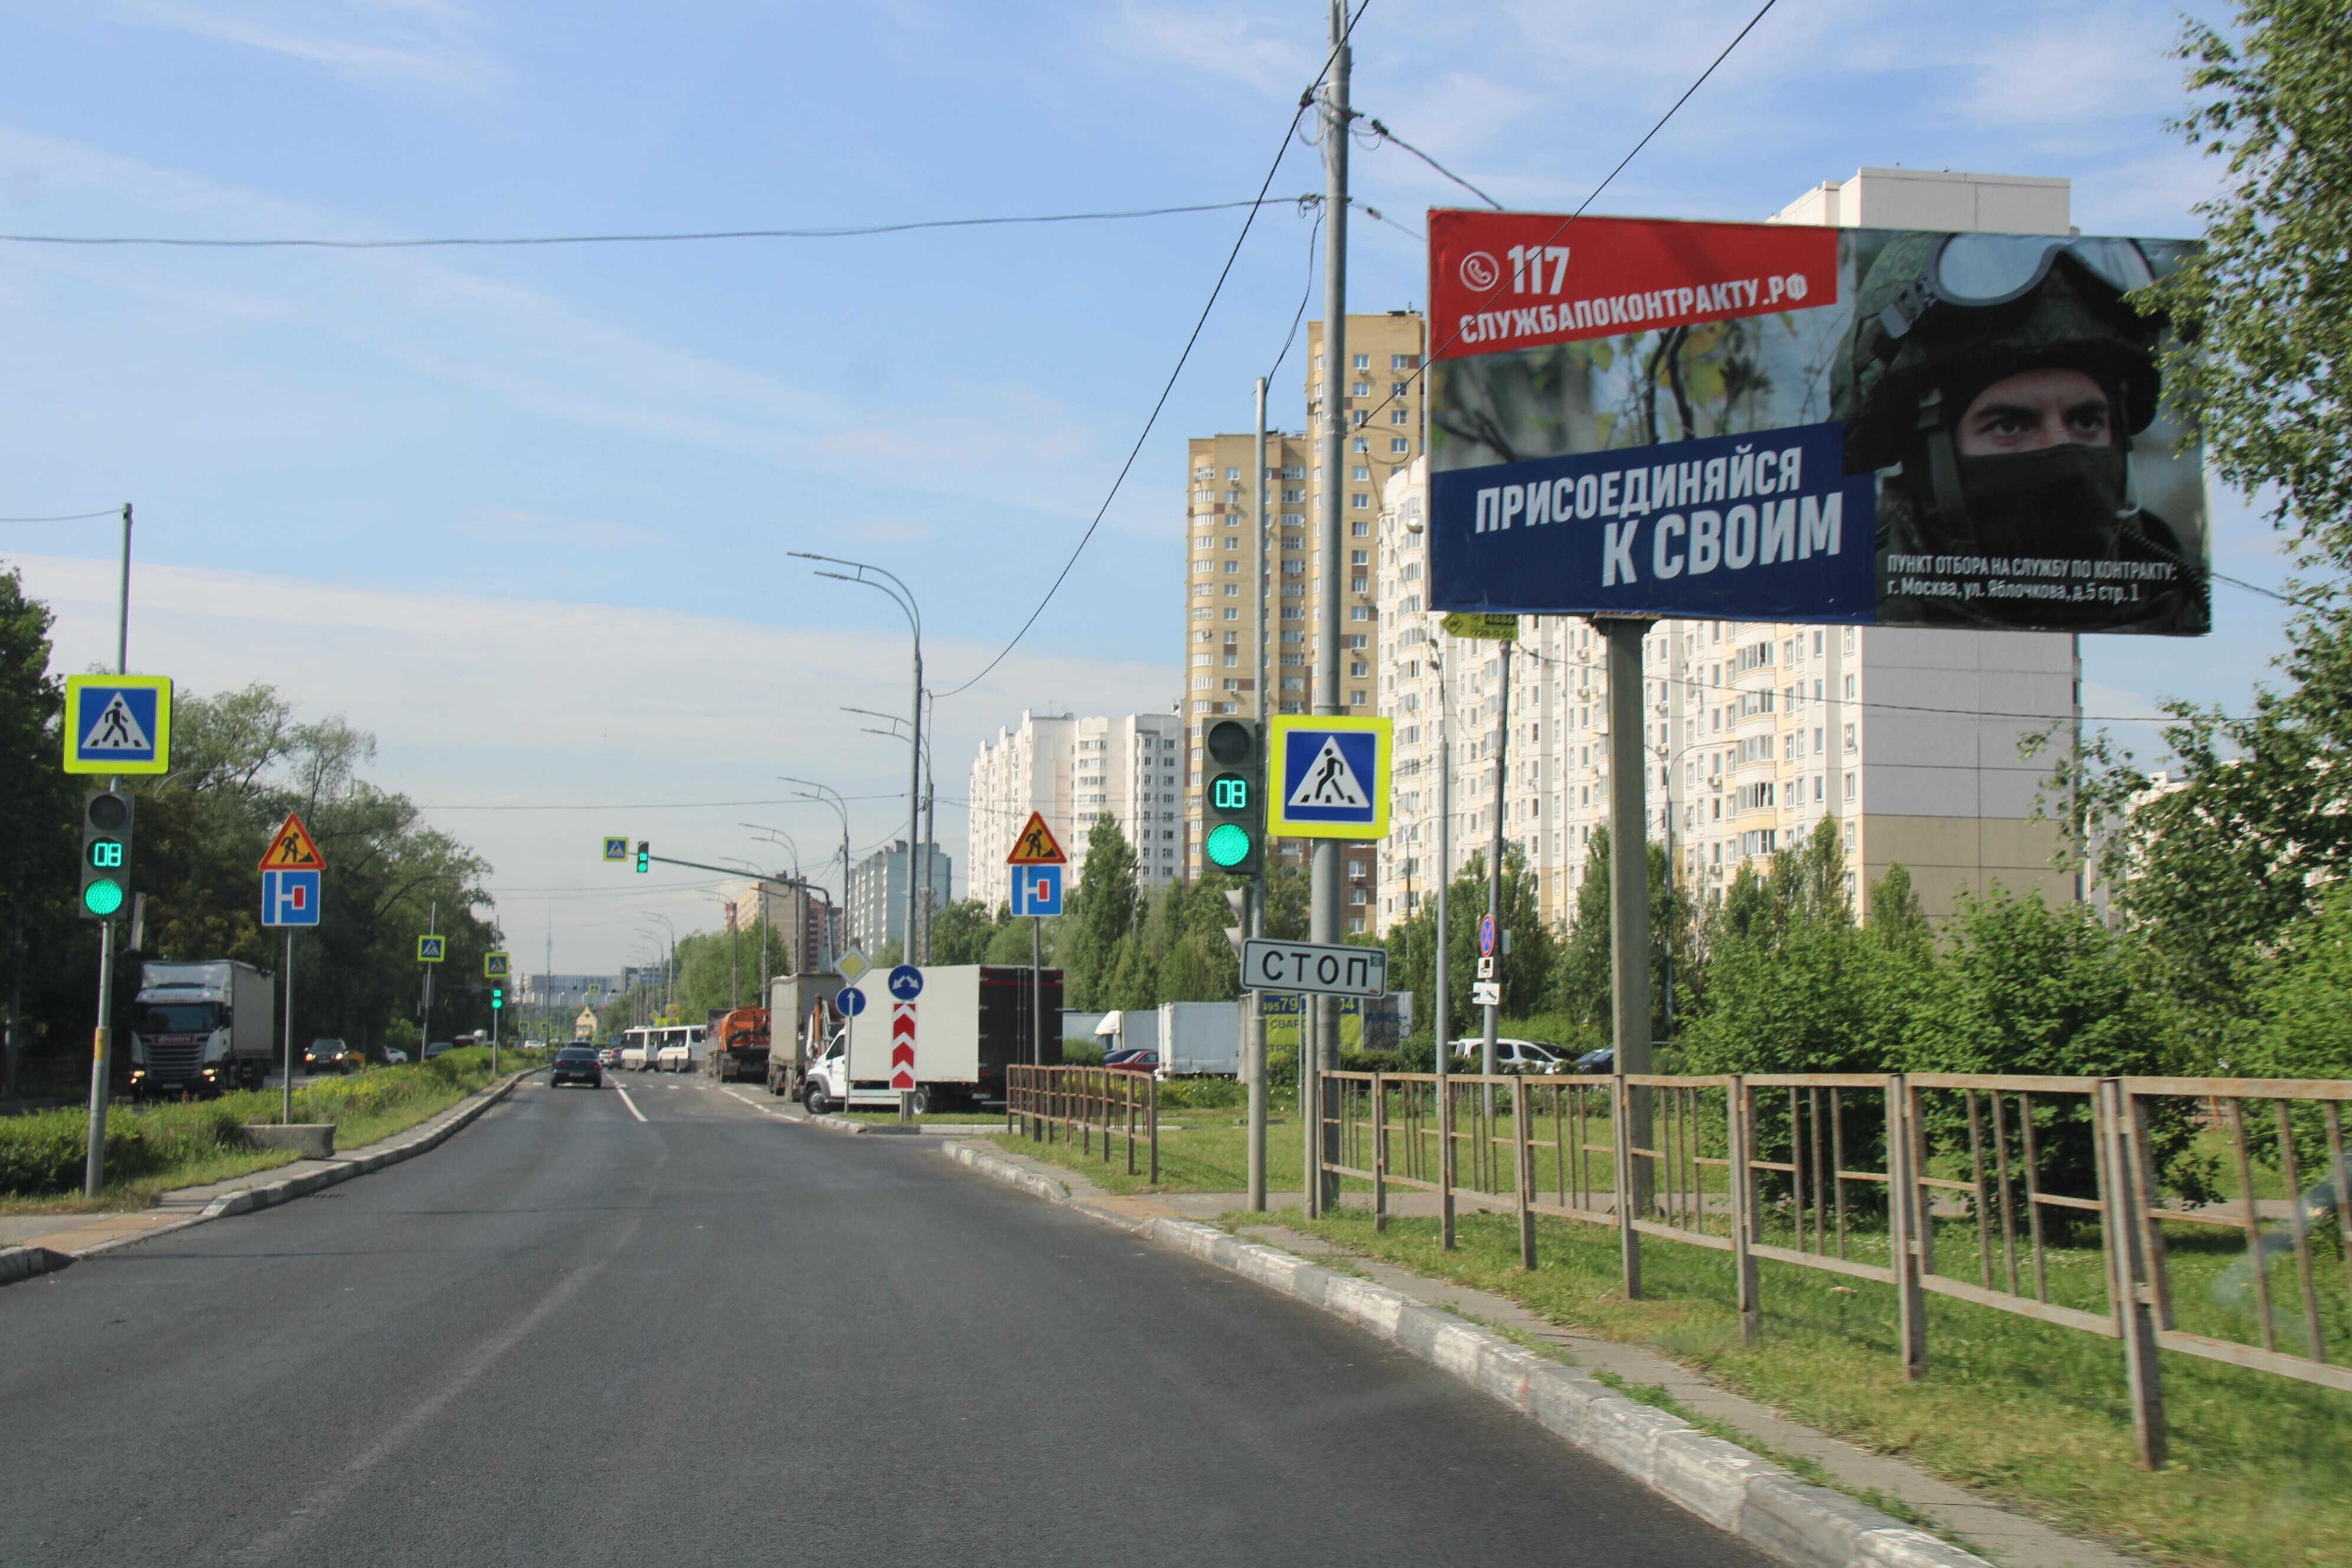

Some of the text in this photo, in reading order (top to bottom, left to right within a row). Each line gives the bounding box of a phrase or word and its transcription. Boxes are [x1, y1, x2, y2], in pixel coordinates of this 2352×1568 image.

[1507, 244, 1570, 295] 117
[1459, 273, 1808, 344] СЛУЖБАПОКОНТРАКТУ.РФ
[1475, 443, 1802, 533] ПРИСОЕДИНЯЙСЯ
[1602, 491, 1843, 587] К СВОИМ
[1887, 554, 2177, 580] ПУНКТ ОТБОРА НА СЛУЖБУ ПО КОНТРАКТУ:
[1887, 580, 1899, 594] г.
[1901, 577, 1962, 600] Москва,
[1963, 582, 1985, 601] ул.
[2130, 583, 2139, 602] 1
[1216, 779, 1246, 808] 08
[94, 842, 122, 867] 08
[1262, 950, 1368, 987] СТОП
